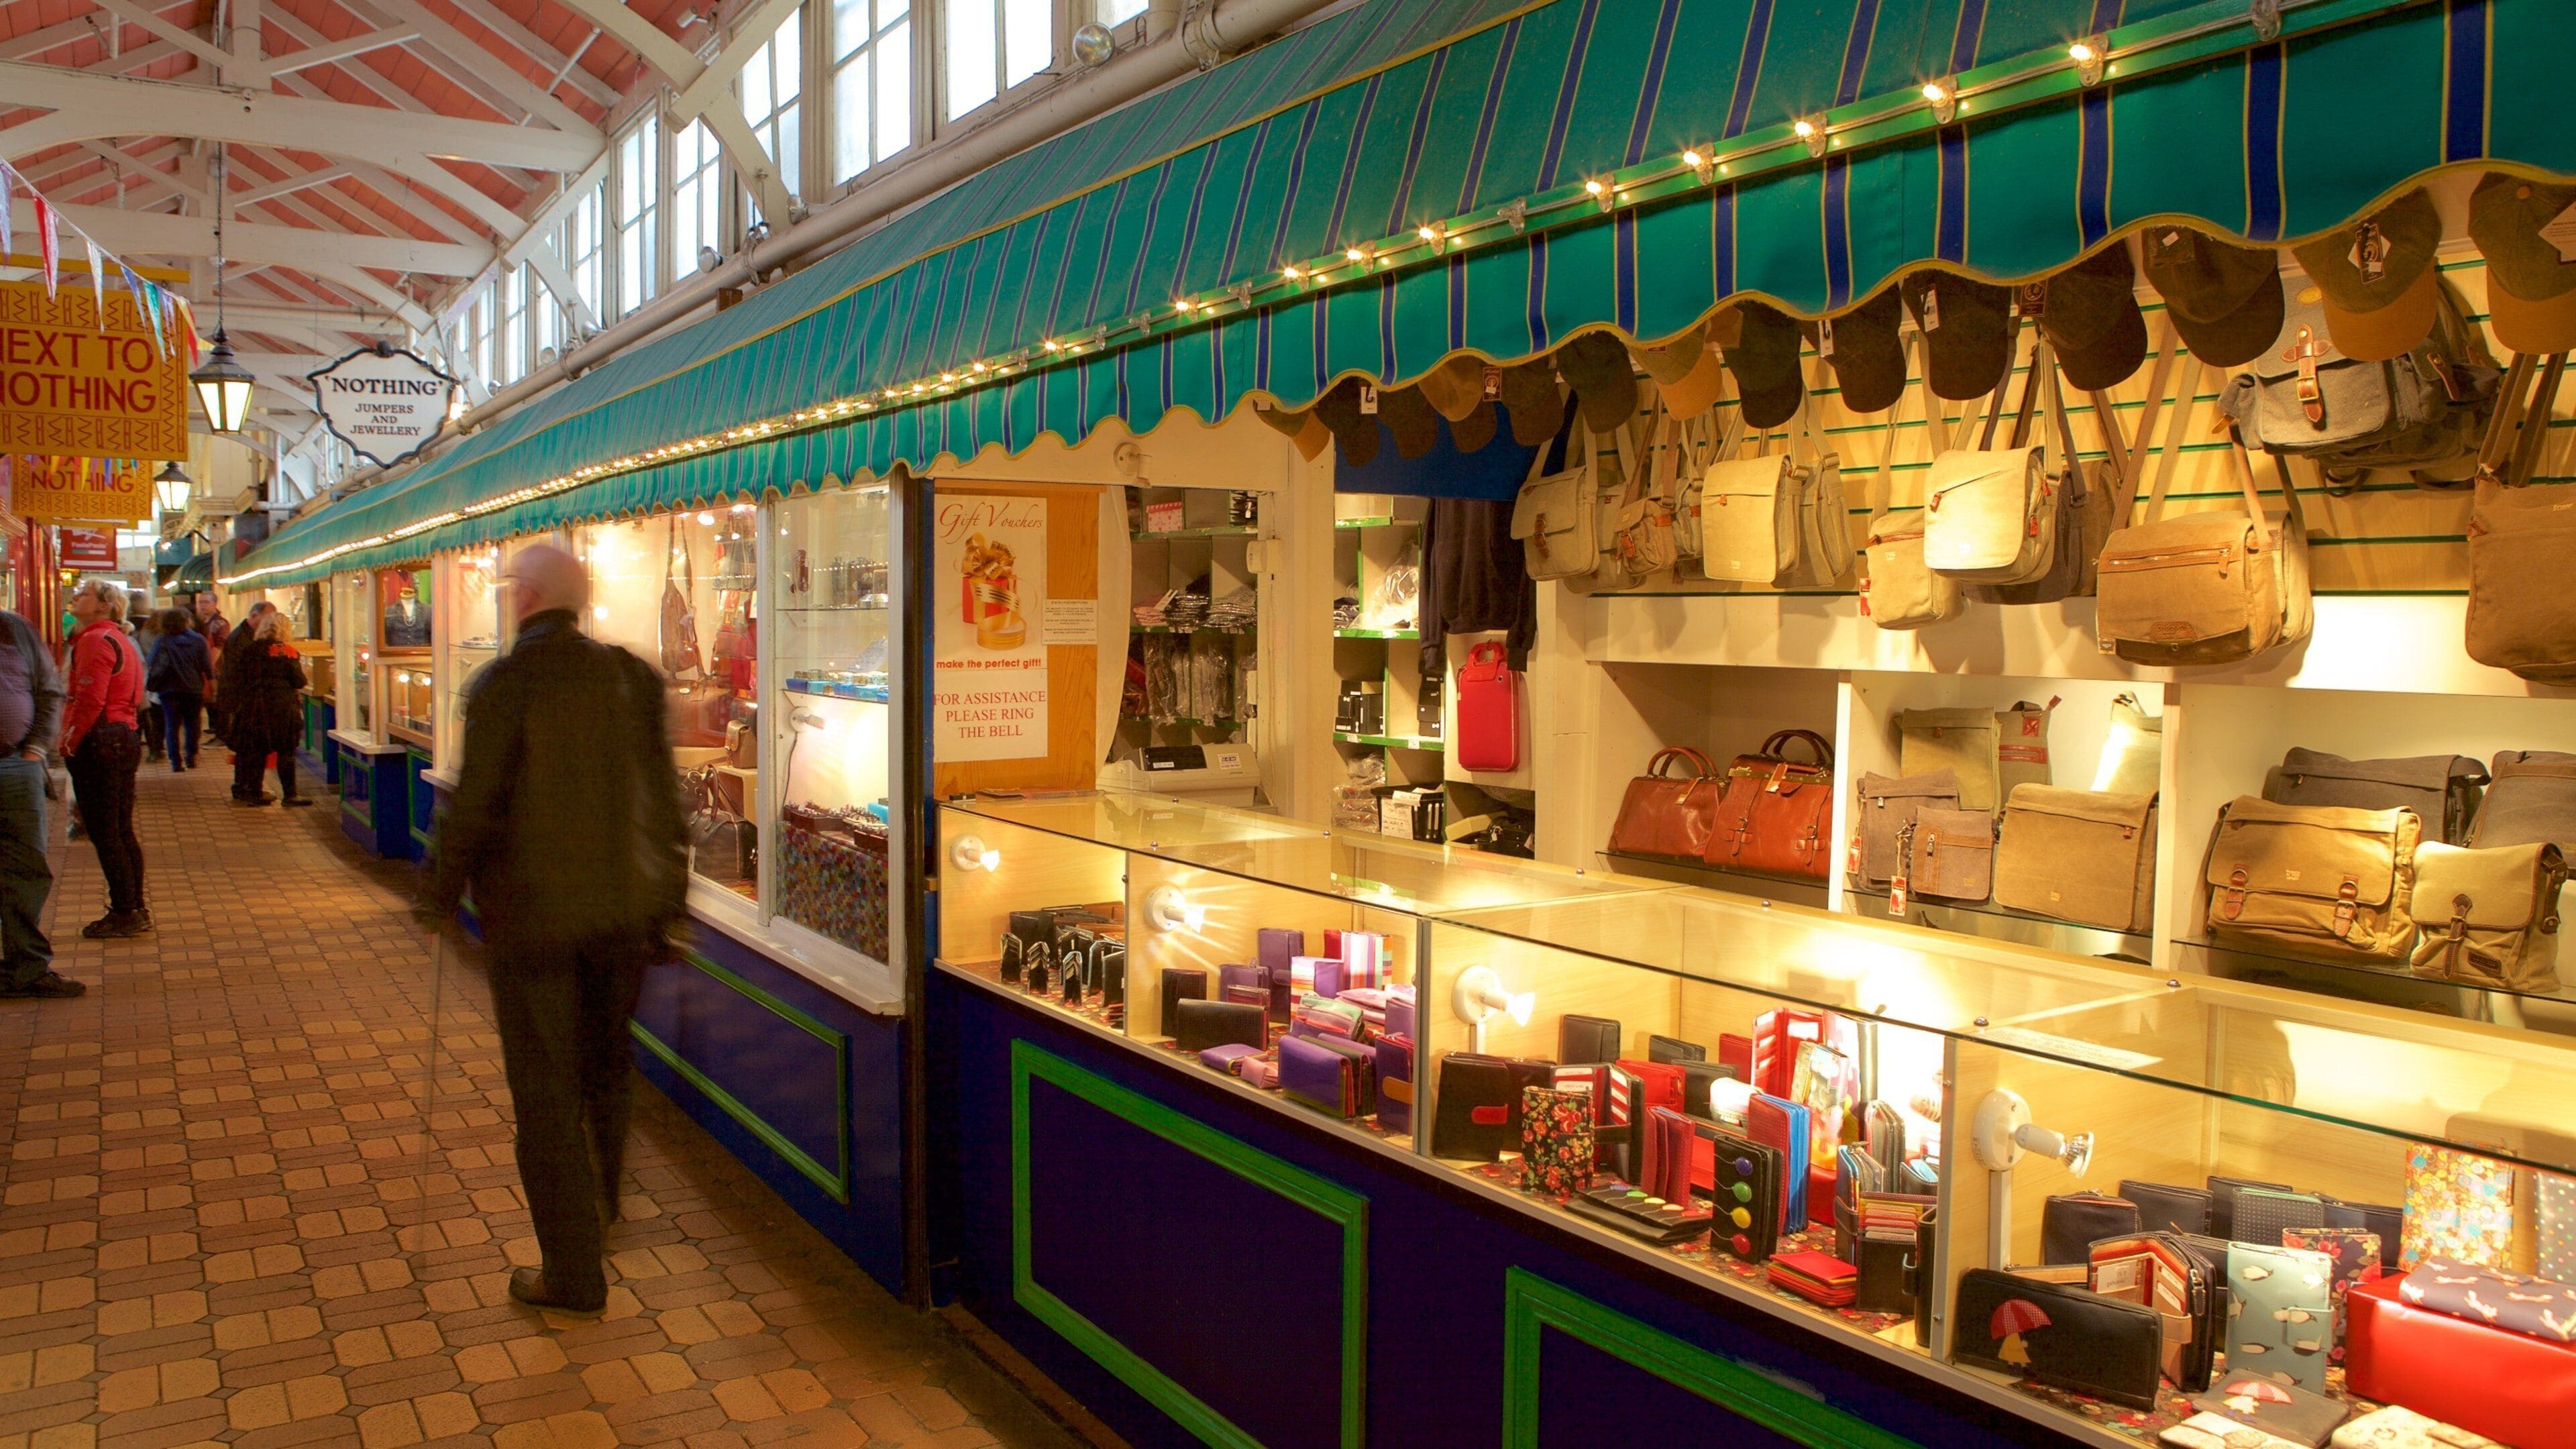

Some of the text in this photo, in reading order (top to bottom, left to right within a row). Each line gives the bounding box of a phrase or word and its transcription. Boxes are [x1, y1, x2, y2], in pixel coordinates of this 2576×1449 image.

[0, 328, 154, 373] EXT TO
[0, 370, 156, 415] OTHING
[354, 403, 414, 413] JUMPERS
[370, 415, 398, 424] AND
[350, 425, 421, 436] JEWELLERY
[940, 502, 1043, 544] Gift Vouchers
[936, 659, 1041, 669] make the perfect gift!
[933, 691, 1046, 706] FOR ASSISTANCE
[946, 708, 1034, 722] PLEASE RING
[958, 725, 1023, 739] THE BELL
